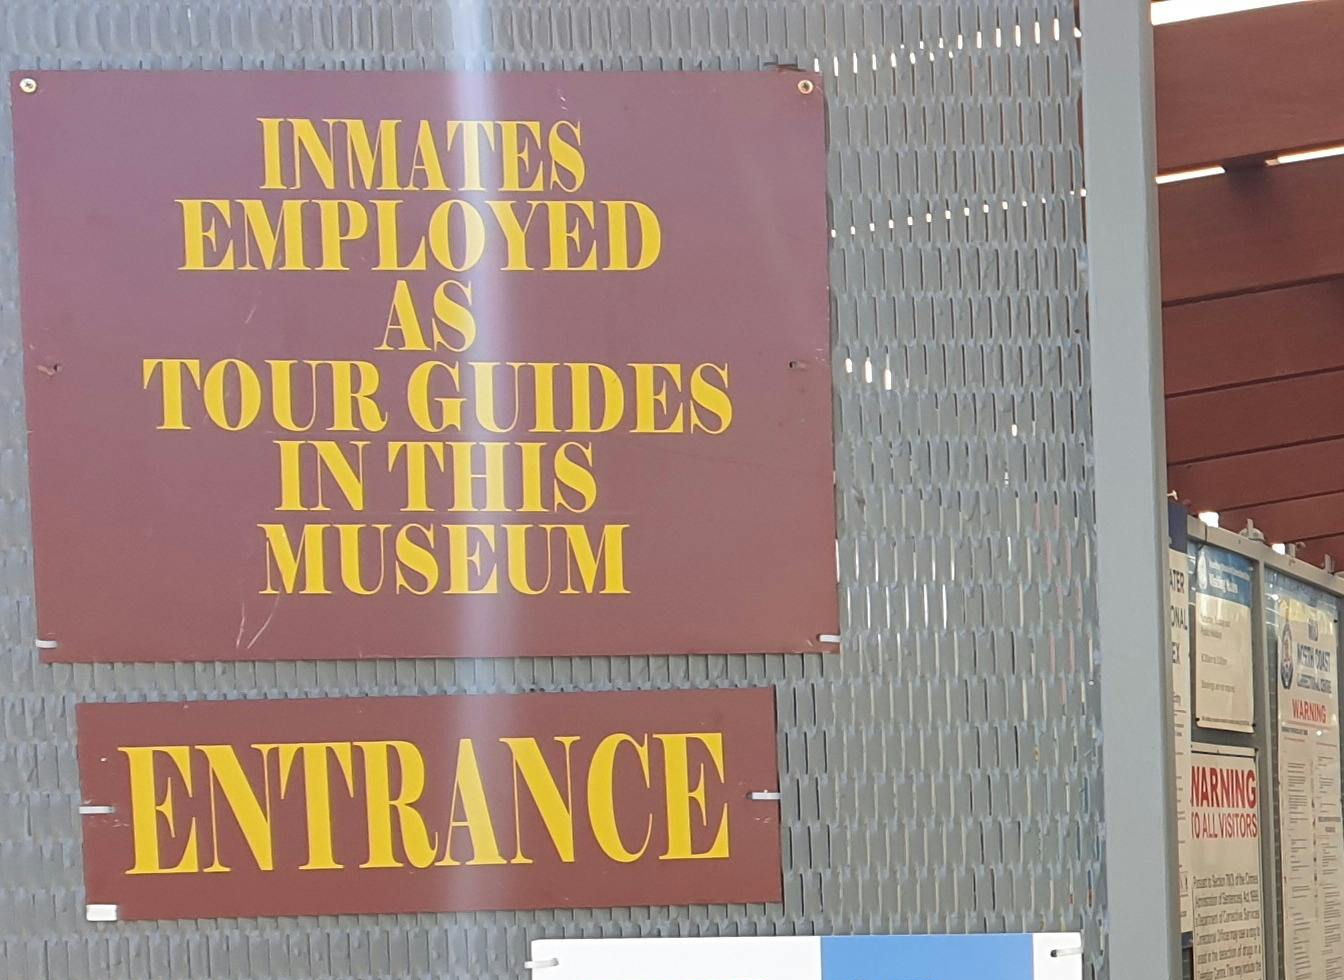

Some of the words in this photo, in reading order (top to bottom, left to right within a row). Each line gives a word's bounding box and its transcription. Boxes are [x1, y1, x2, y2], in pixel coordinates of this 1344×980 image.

[256, 118, 585, 192] INMATES
[174, 200, 661, 271] EMPLOYED
[374, 280, 476, 352] AS
[143, 359, 388, 432] TOUR
[408, 361, 732, 434] GUIDES
[273, 441, 371, 510] IN
[388, 442, 596, 513] THIS
[257, 523, 631, 595] MUSEUM
[1292, 698, 1327, 724] WARNING
[117, 733, 729, 874] ENTRANCE
[1202, 813, 1218, 839] ALL
[1218, 813, 1257, 839] VISITORS
